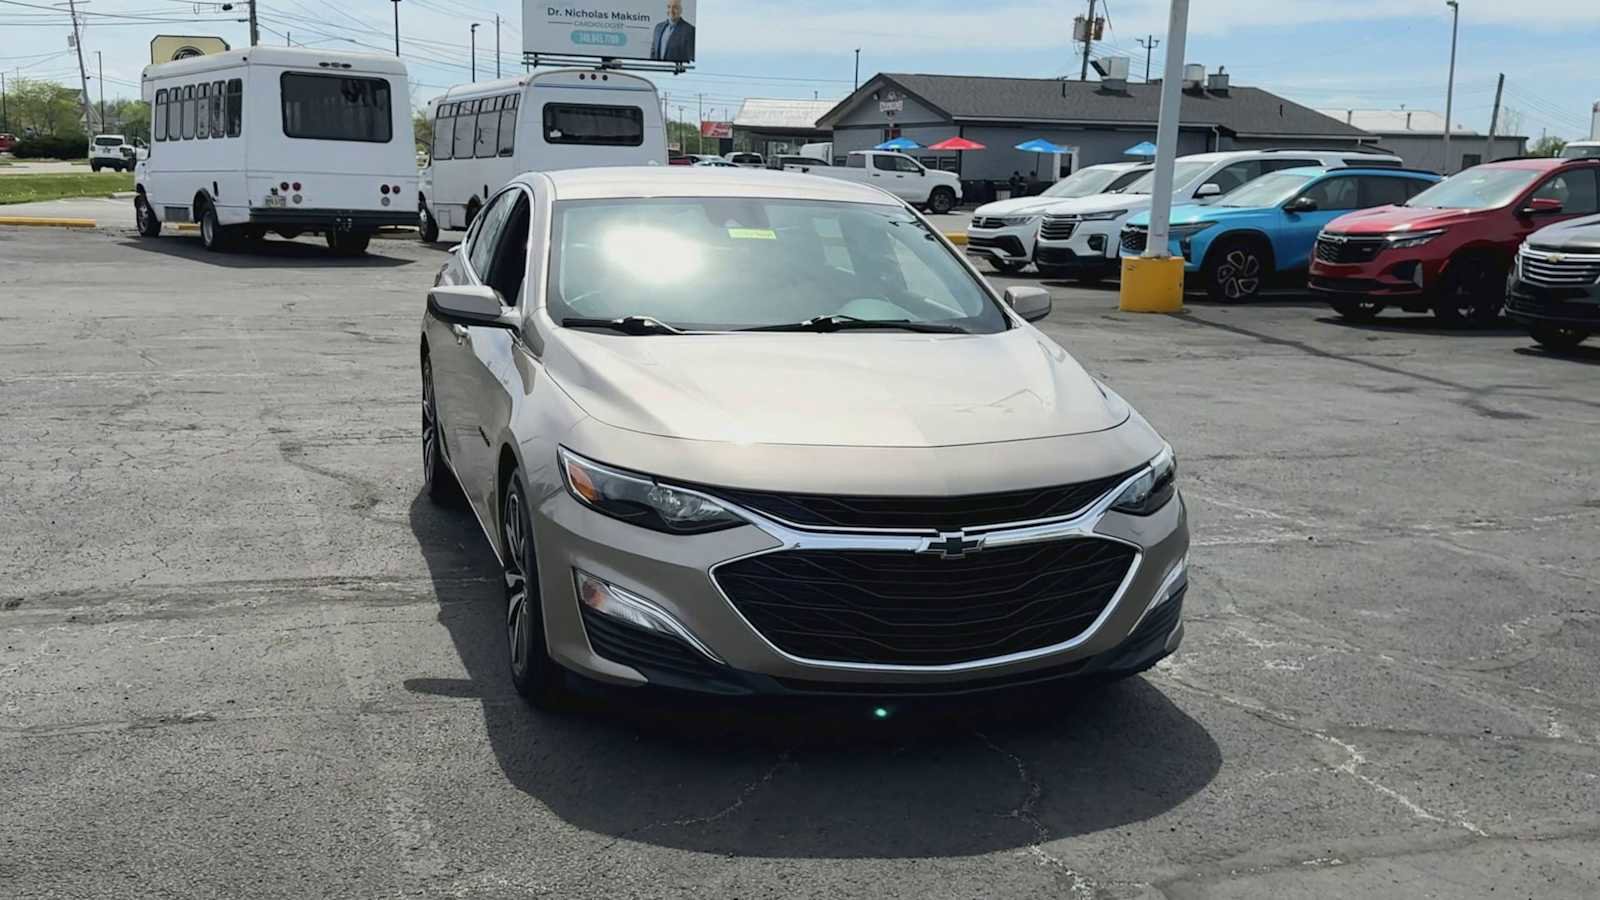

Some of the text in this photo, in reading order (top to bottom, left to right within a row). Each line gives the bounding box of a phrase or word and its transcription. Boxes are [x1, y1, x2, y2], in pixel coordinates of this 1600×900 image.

[547, 7, 650, 22] Dr. Nicholas Maksim
